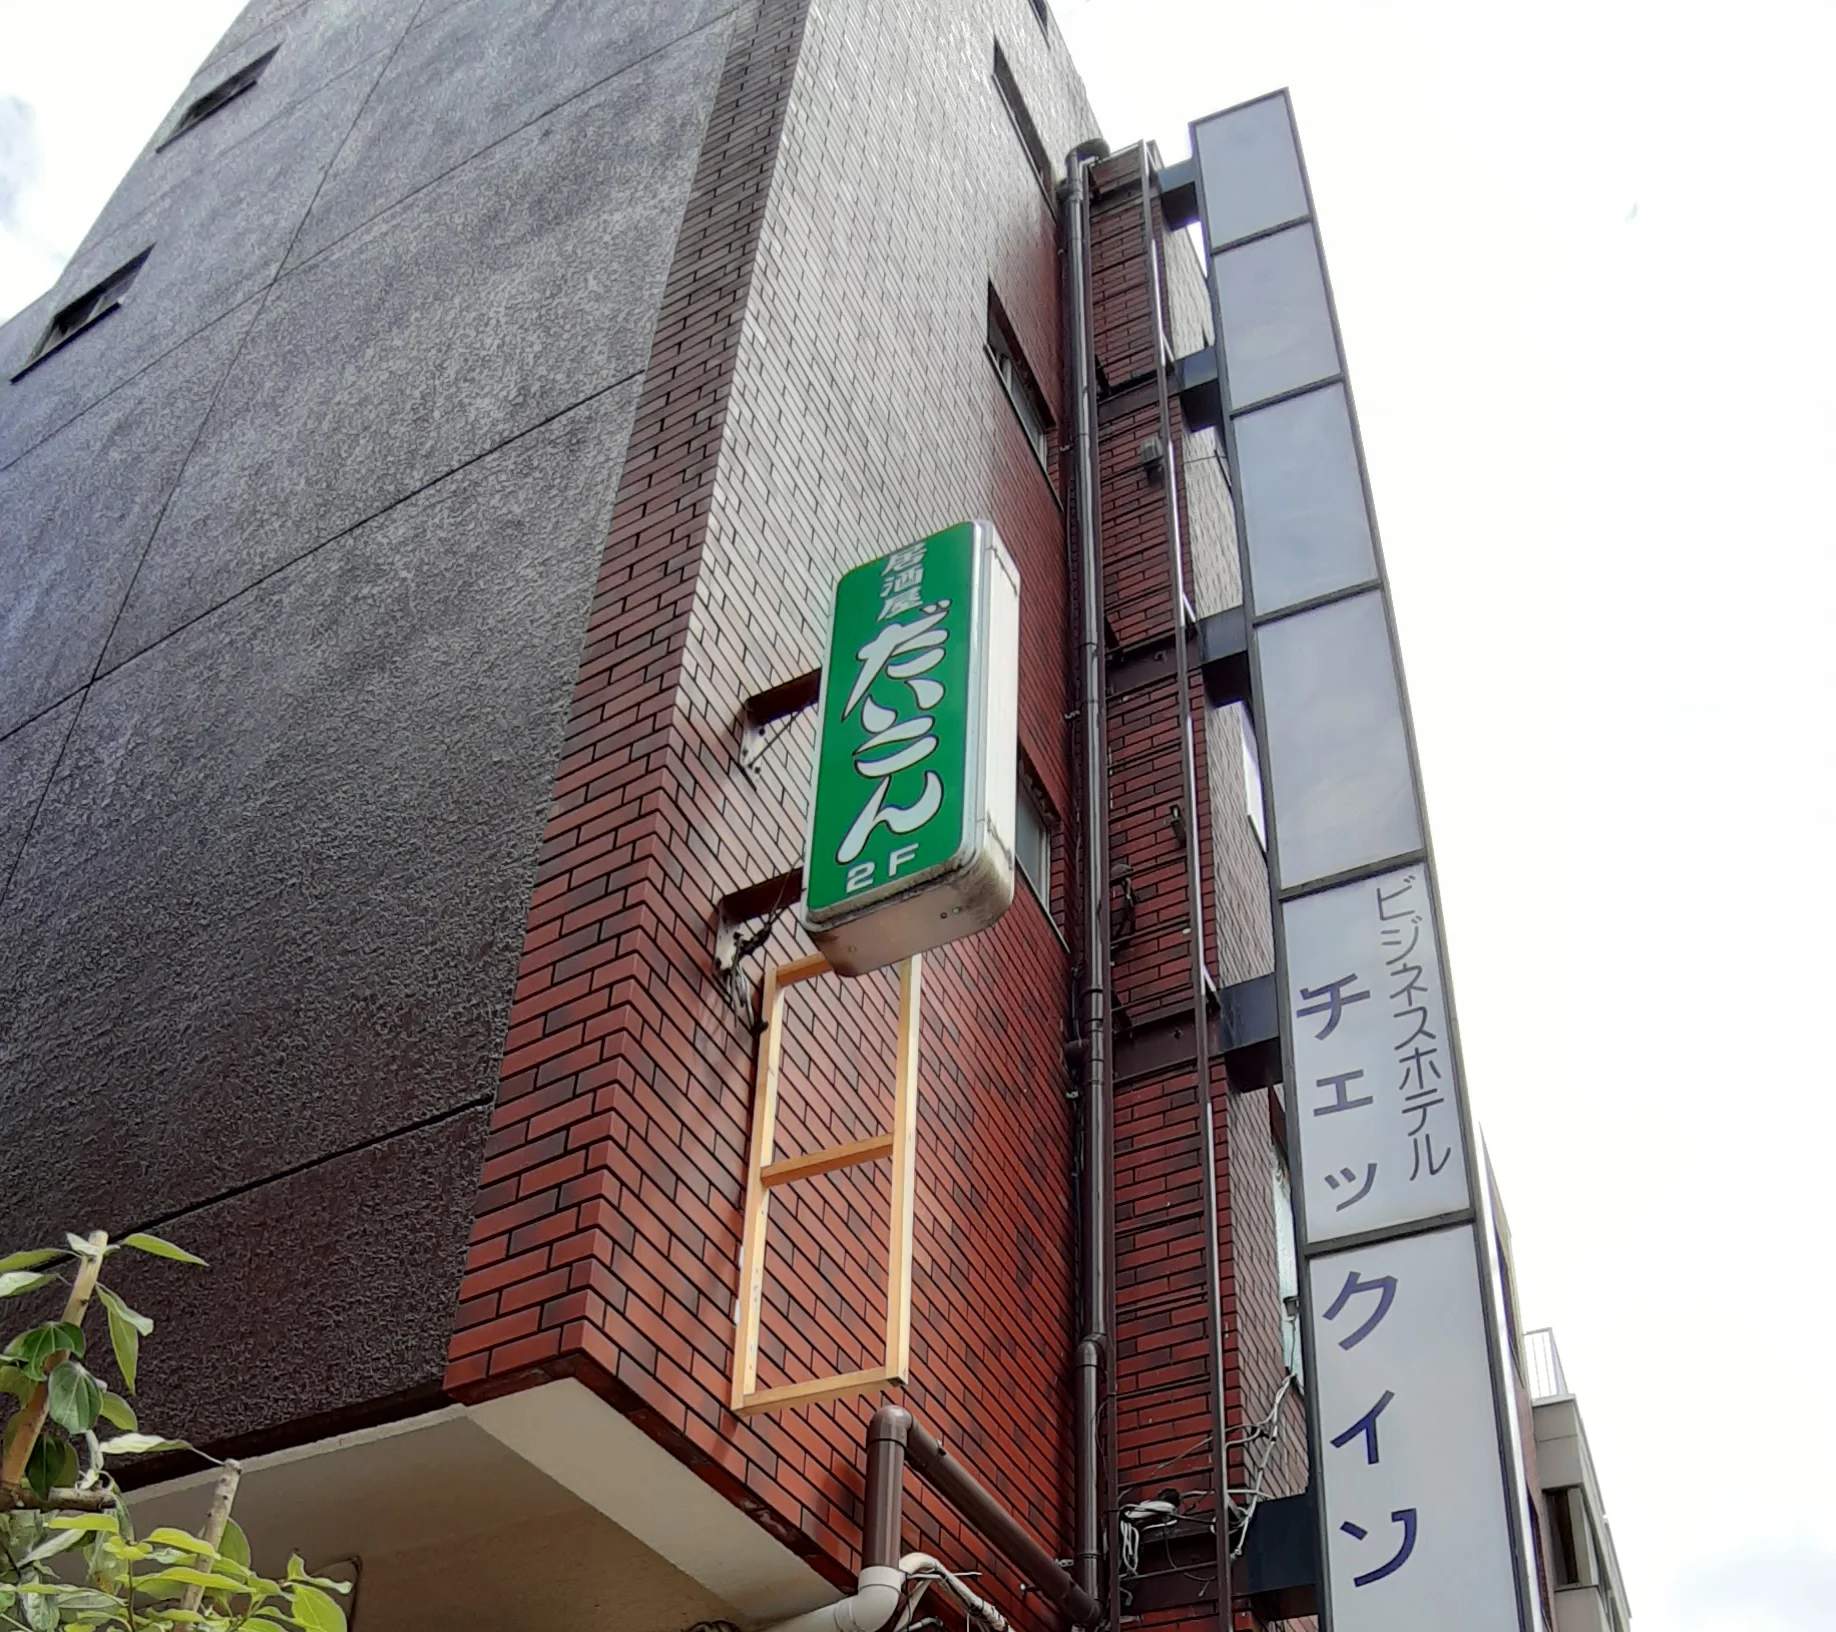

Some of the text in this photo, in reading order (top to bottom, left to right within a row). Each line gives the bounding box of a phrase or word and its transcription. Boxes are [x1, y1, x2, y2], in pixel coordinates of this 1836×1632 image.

[877, 541, 928, 621] 居酒屋
[836, 598, 952, 865] だいこん
[846, 842, 920, 894] 2F
[1375, 876, 1451, 1183] ビジネスホテル
